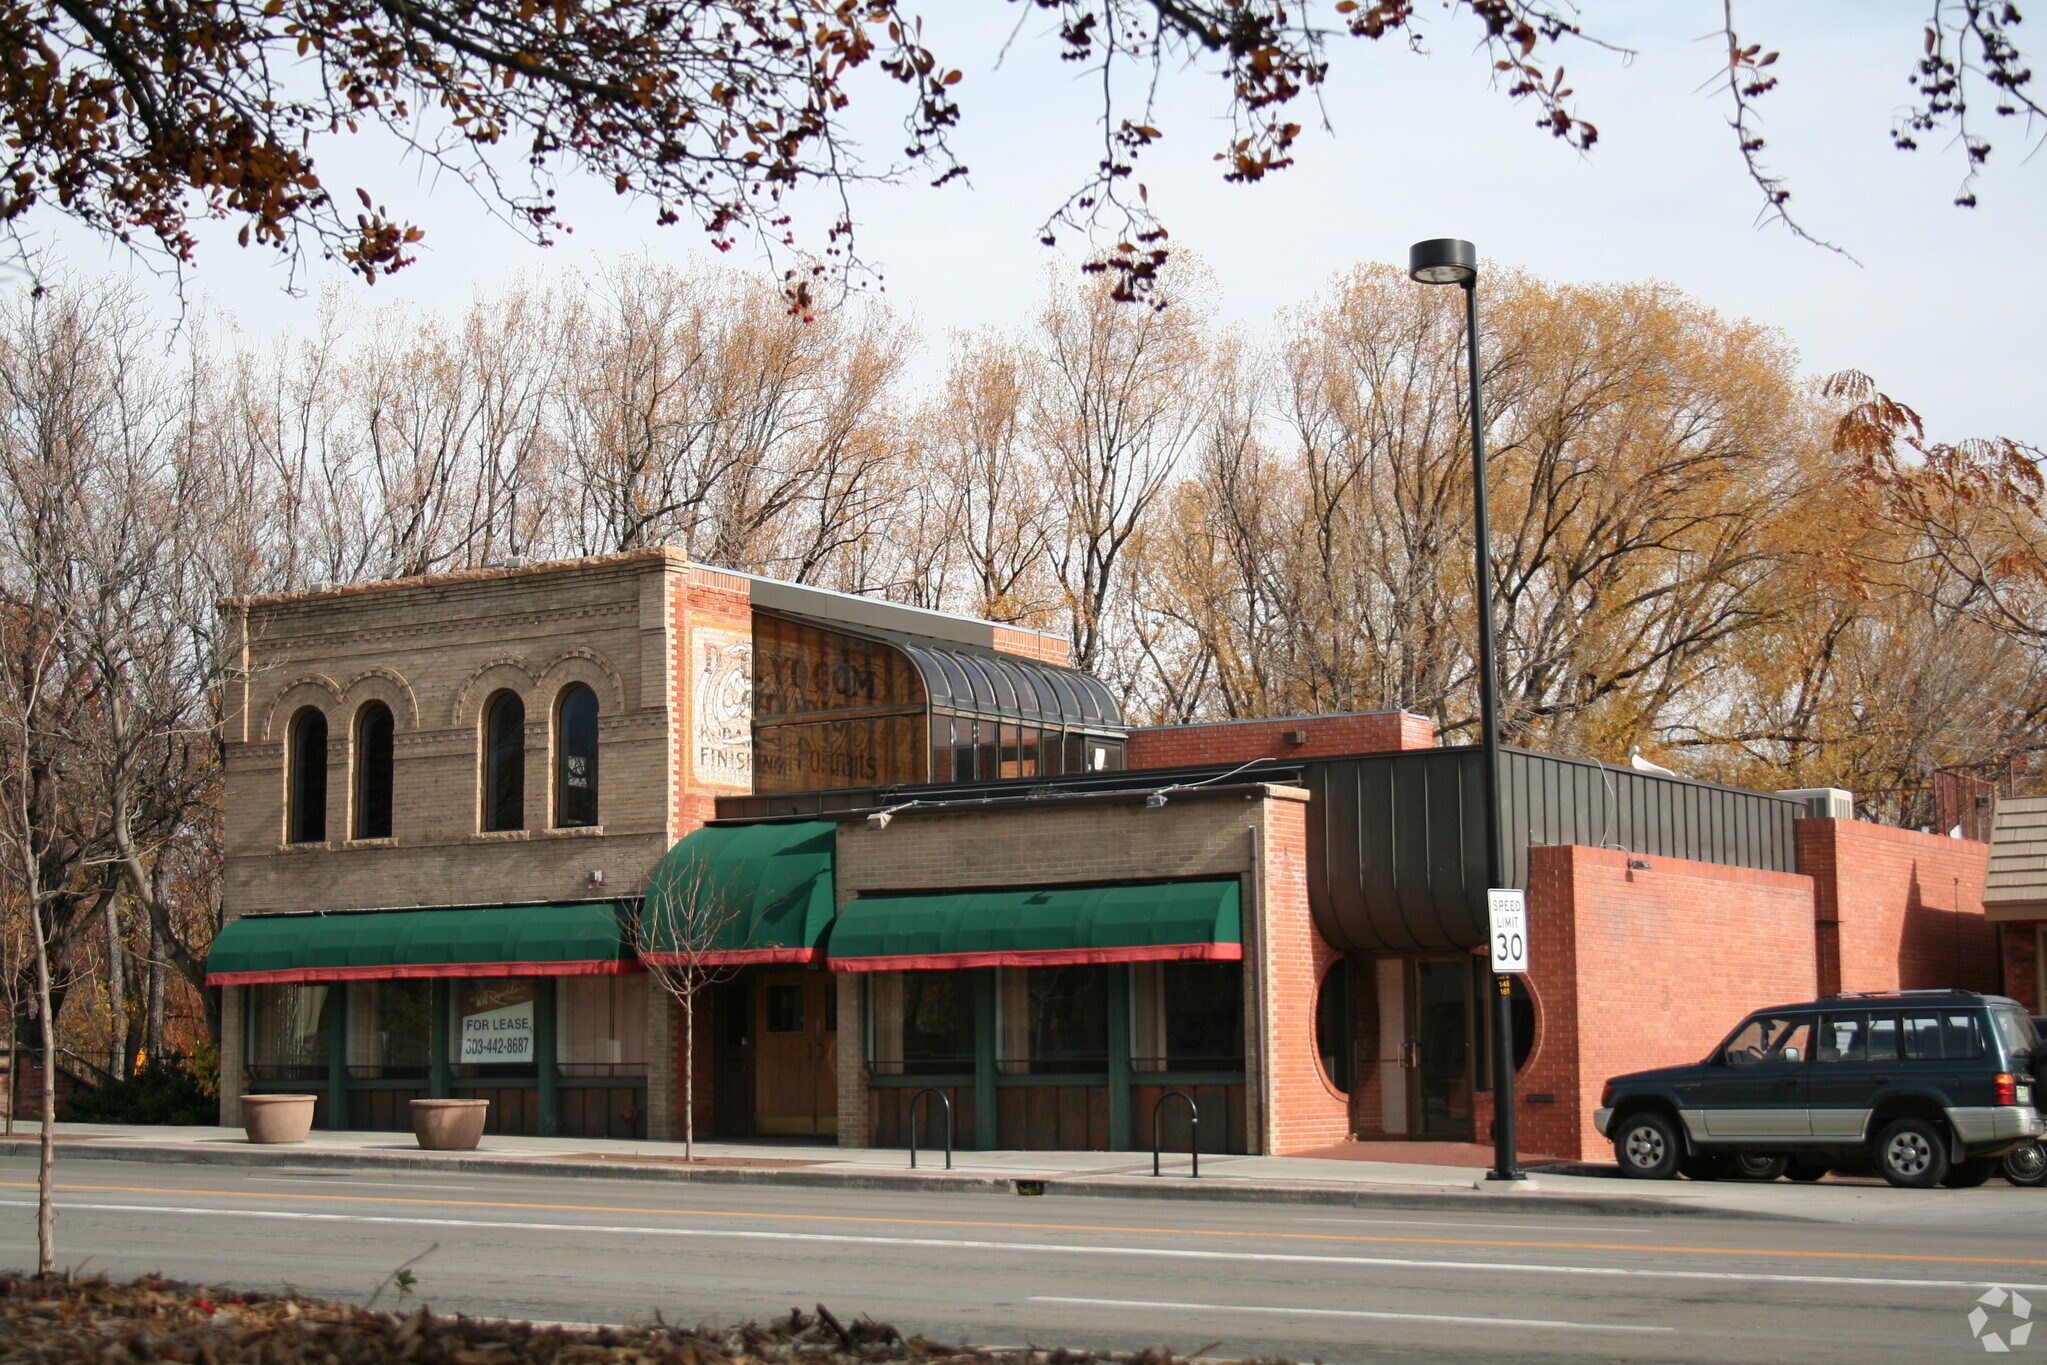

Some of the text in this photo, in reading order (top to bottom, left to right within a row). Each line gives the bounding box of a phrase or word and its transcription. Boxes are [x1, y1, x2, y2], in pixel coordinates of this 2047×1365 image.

[1493, 900, 1521, 912] SPEED
[1497, 916, 1519, 929] LIMIT
[1497, 932, 1522, 961] 30
[466, 1017, 529, 1031] FOR LEASE
[465, 1037, 529, 1054] 303-442-8687
